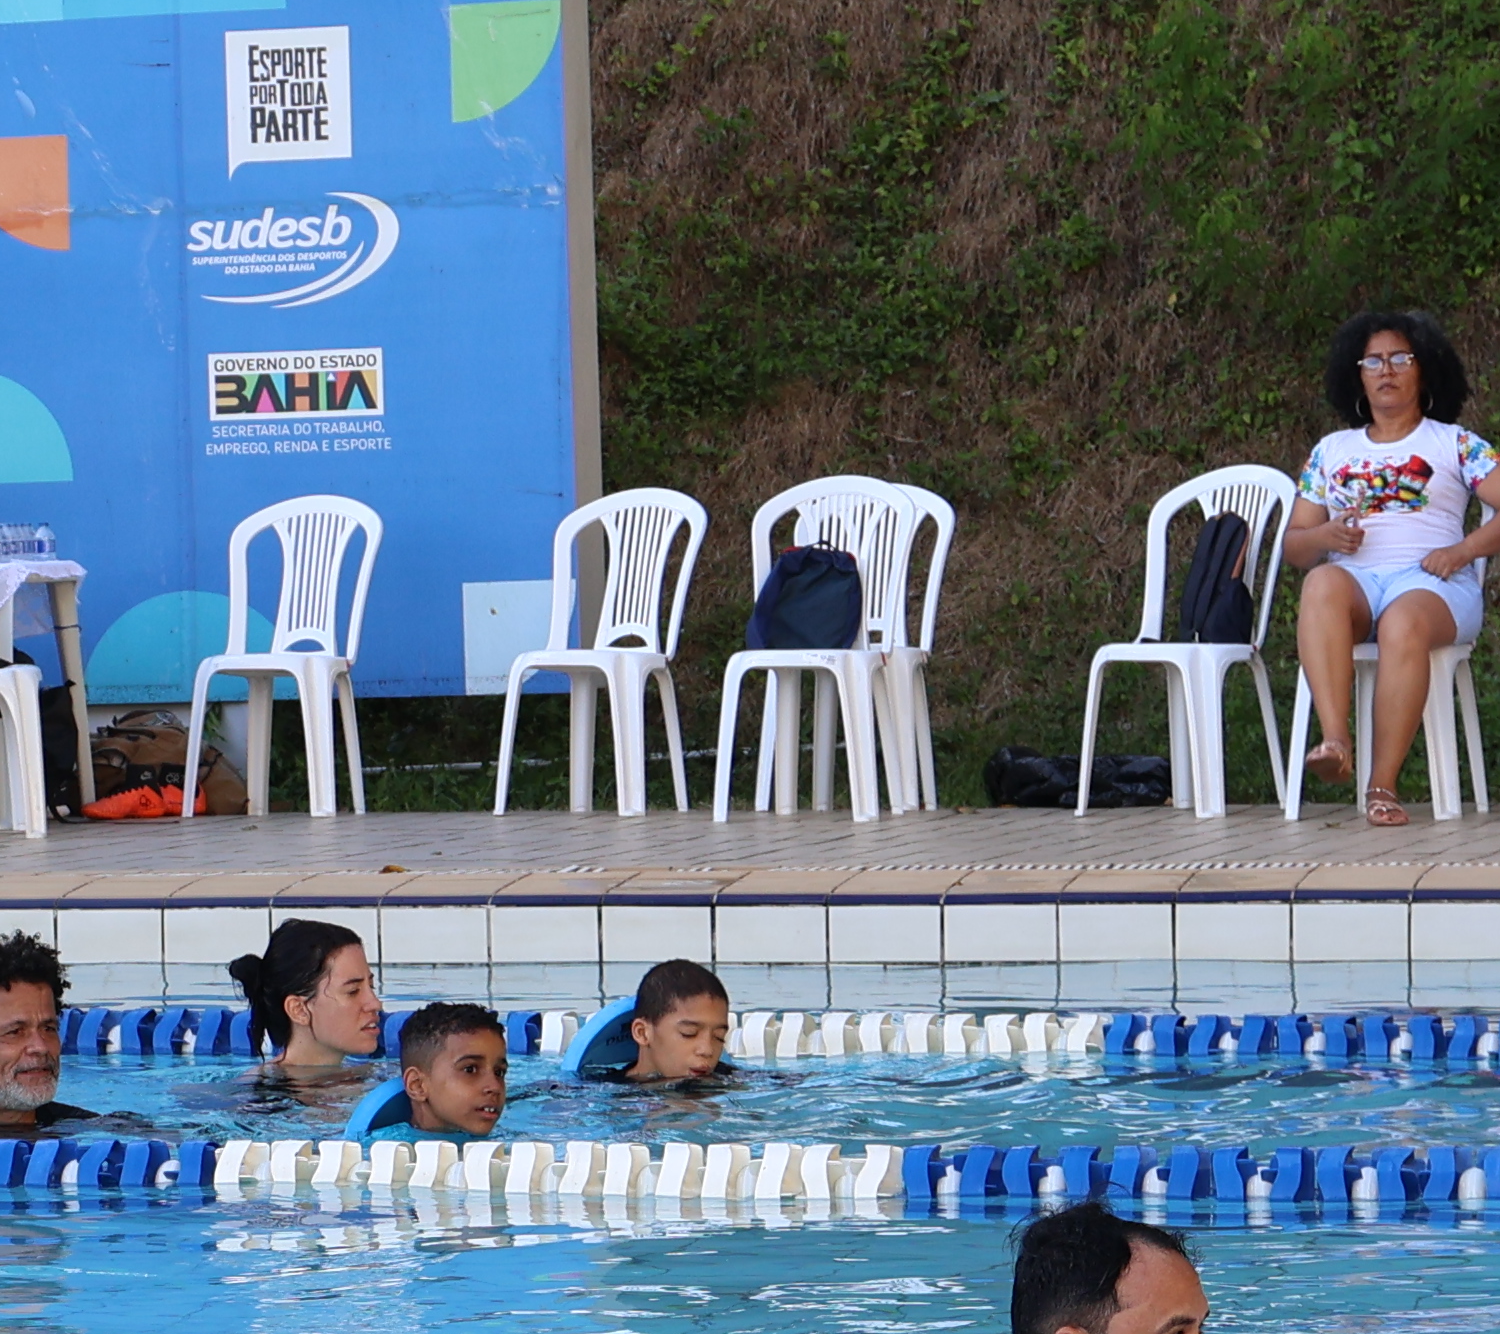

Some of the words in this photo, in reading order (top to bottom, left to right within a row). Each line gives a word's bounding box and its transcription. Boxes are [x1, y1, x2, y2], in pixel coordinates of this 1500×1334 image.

[248, 44, 328, 83] ESPORTE
[249, 83, 278, 106] POR
[276, 78, 329, 108] TODA
[250, 106, 329, 144] PARTE
[186, 204, 353, 252] sudesb
[192, 253, 276, 265] SUPERINTENDÊNCIA
[277, 252, 295, 262] DOS
[297, 250, 348, 261] DESPORTOS
[224, 266, 239, 275] DO
[239, 264, 273, 274] ESTADO
[274, 264, 288, 273] DA
[288, 262, 316, 272] BAHIA
[213, 356, 289, 373] GOVERNO
[294, 355, 315, 370] DO
[319, 353, 378, 369] ESTADO
[215, 369, 379, 415] BAHIA
[212, 422, 291, 438] SECRETARIA
[293, 422, 312, 435] DO
[314, 420, 386, 435] TRABALHO,
[206, 441, 271, 456] EMPREGO,
[274, 440, 319, 454] RENDA
[322, 439, 330, 452] E
[334, 437, 392, 452] ESPORTE
